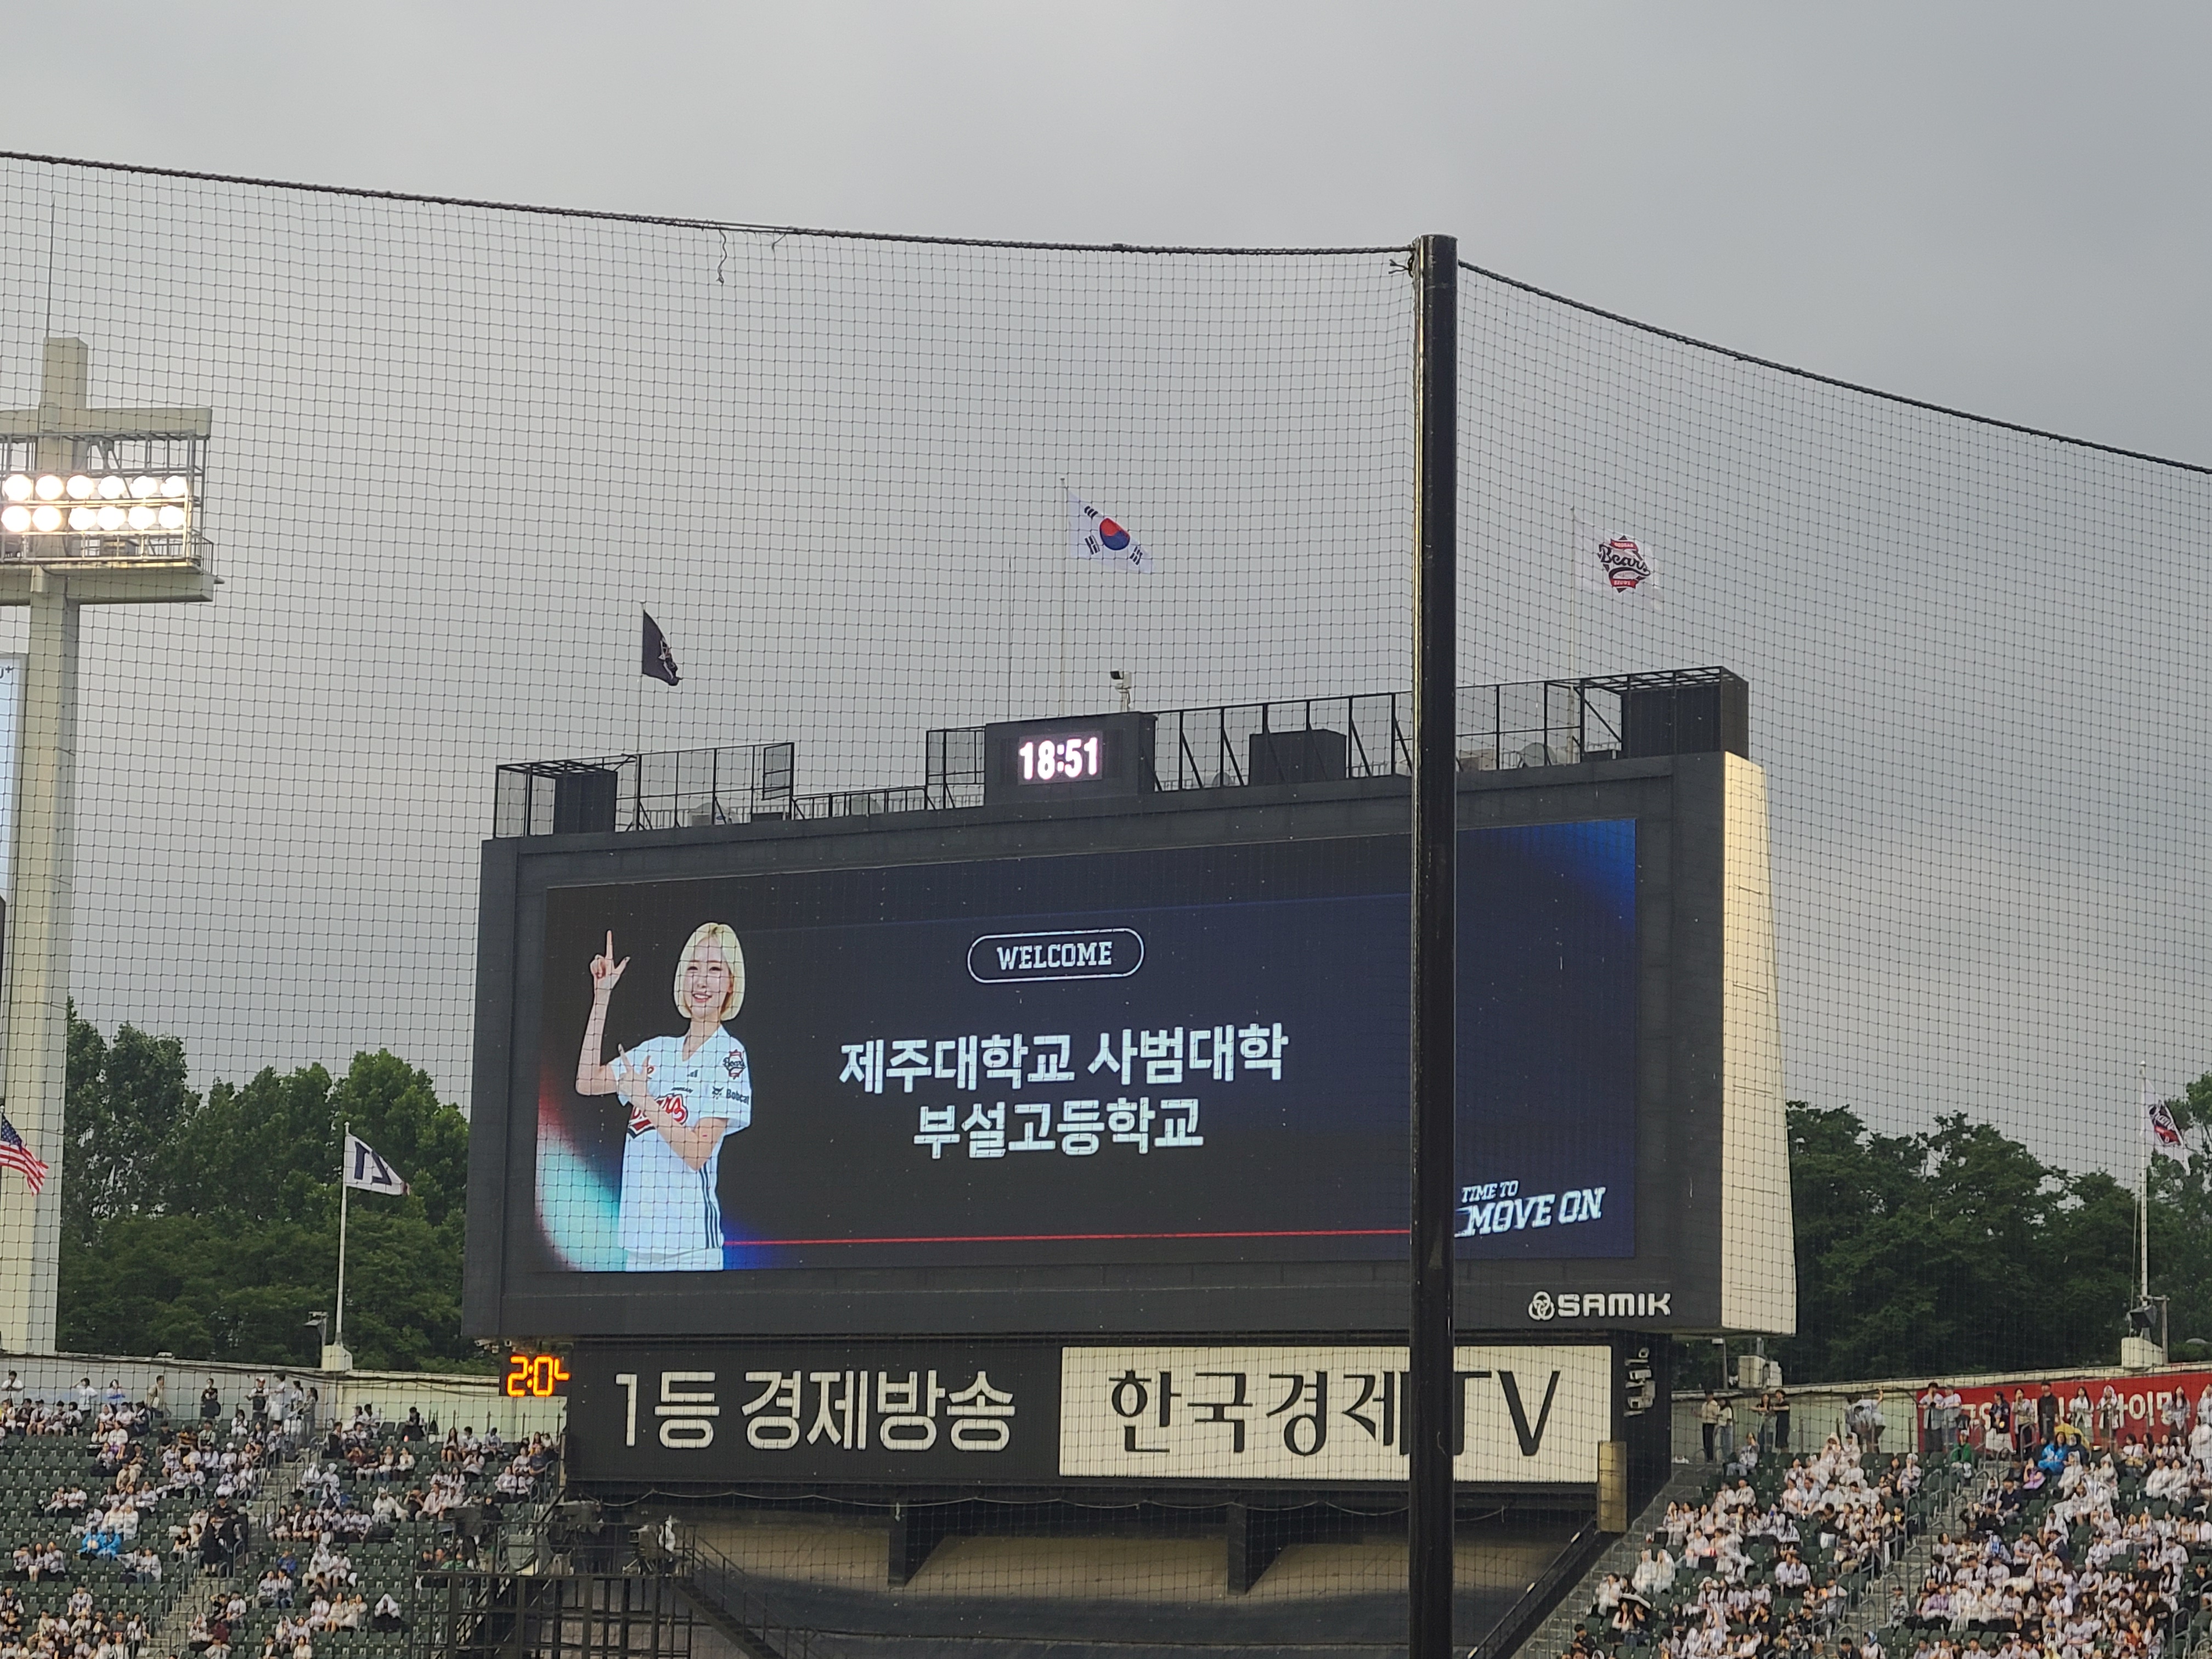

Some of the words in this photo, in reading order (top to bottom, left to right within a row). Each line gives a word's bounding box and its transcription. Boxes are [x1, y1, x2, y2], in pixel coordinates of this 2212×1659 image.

[1019, 737, 1097, 780] 18:51
[996, 941, 1113, 970] WELCOME
[839, 1034, 1075, 1093] 제주대학교
[1087, 1023, 1289, 1085] 사범대학
[913, 1097, 1204, 1159] 부설고등학교
[1457, 1194, 1556, 1238] MOVE
[1558, 1187, 1606, 1223] ON
[1462, 1183, 1497, 1203] TIME
[1500, 1180, 1519, 1198] TO
[1558, 1293, 1671, 1317] SAMIK
[616, 1372, 720, 1449] 1등
[741, 1370, 1015, 1451] 경제방송
